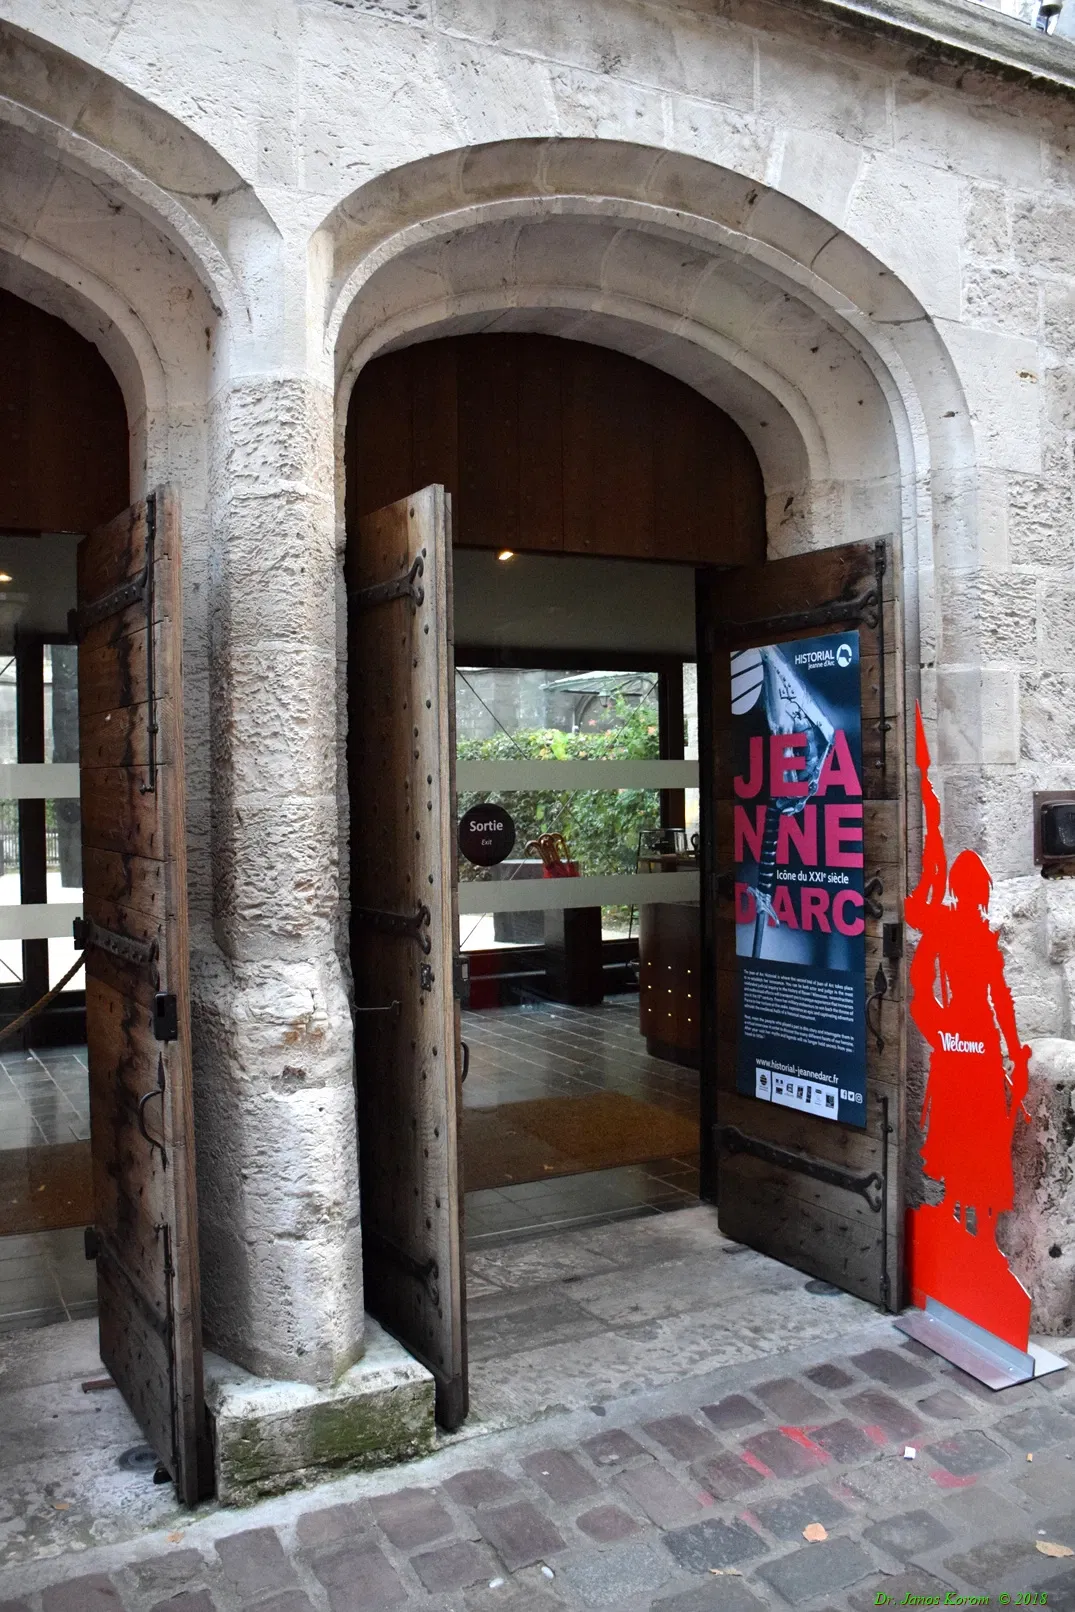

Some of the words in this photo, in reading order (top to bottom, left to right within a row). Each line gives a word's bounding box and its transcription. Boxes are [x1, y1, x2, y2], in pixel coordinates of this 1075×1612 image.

[795, 650, 835, 664] HISTORIAL
[733, 729, 863, 799] JEA
[469, 820, 504, 831] Sortie
[734, 804, 864, 868] NNE
[777, 869, 796, 881] Icône
[797, 871, 808, 882] du
[827, 872, 849, 883] siècle
[937, 1030, 985, 1054] Welcome
[755, 1058, 839, 1084] www.historial-jeannedarc.fr
